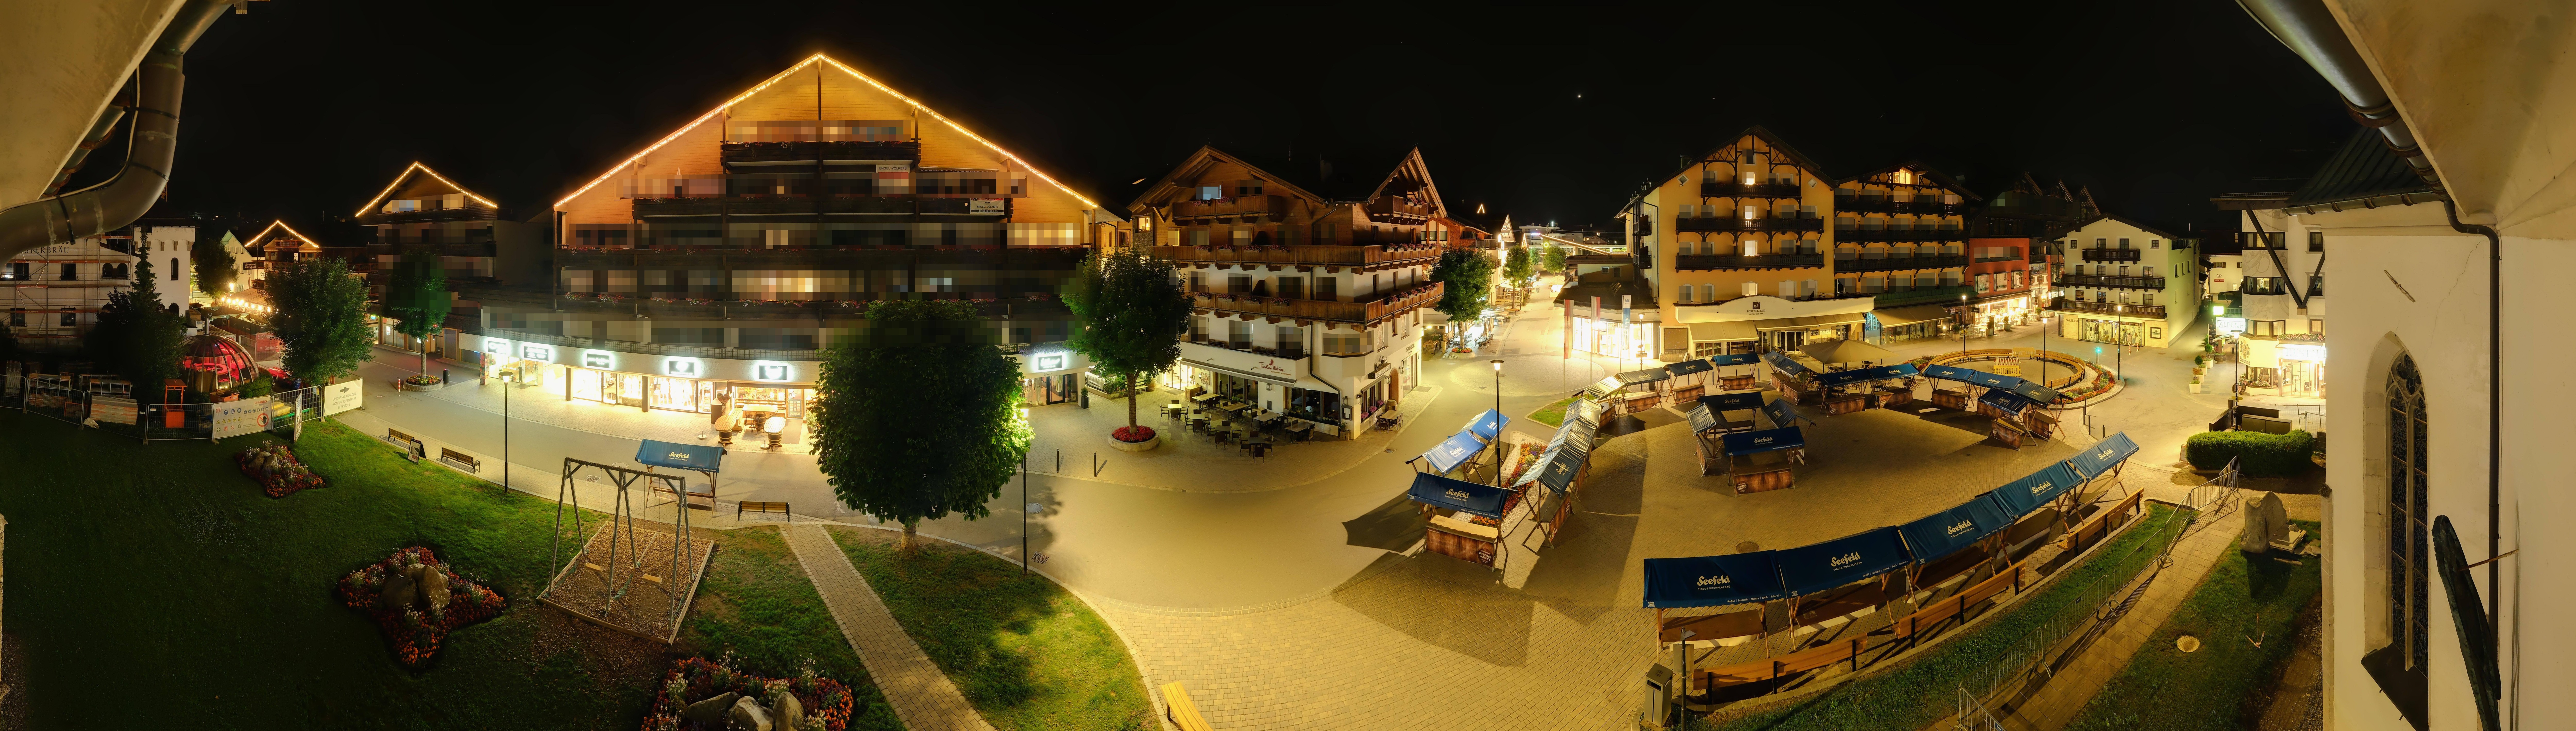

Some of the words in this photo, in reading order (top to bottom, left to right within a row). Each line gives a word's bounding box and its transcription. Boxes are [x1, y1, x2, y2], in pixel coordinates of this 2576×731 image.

[332, 397, 356, 406] KONGRESSZENTRUM
[2098, 448, 2113, 459] Seefeld
[2032, 481, 2051, 494] Seefeld
[1446, 488, 1469, 499] Seefeld
[1947, 519, 1972, 534] Seefeld
[1831, 551, 1861, 567] Seefeld
[1697, 575, 1730, 586] Seefeld
